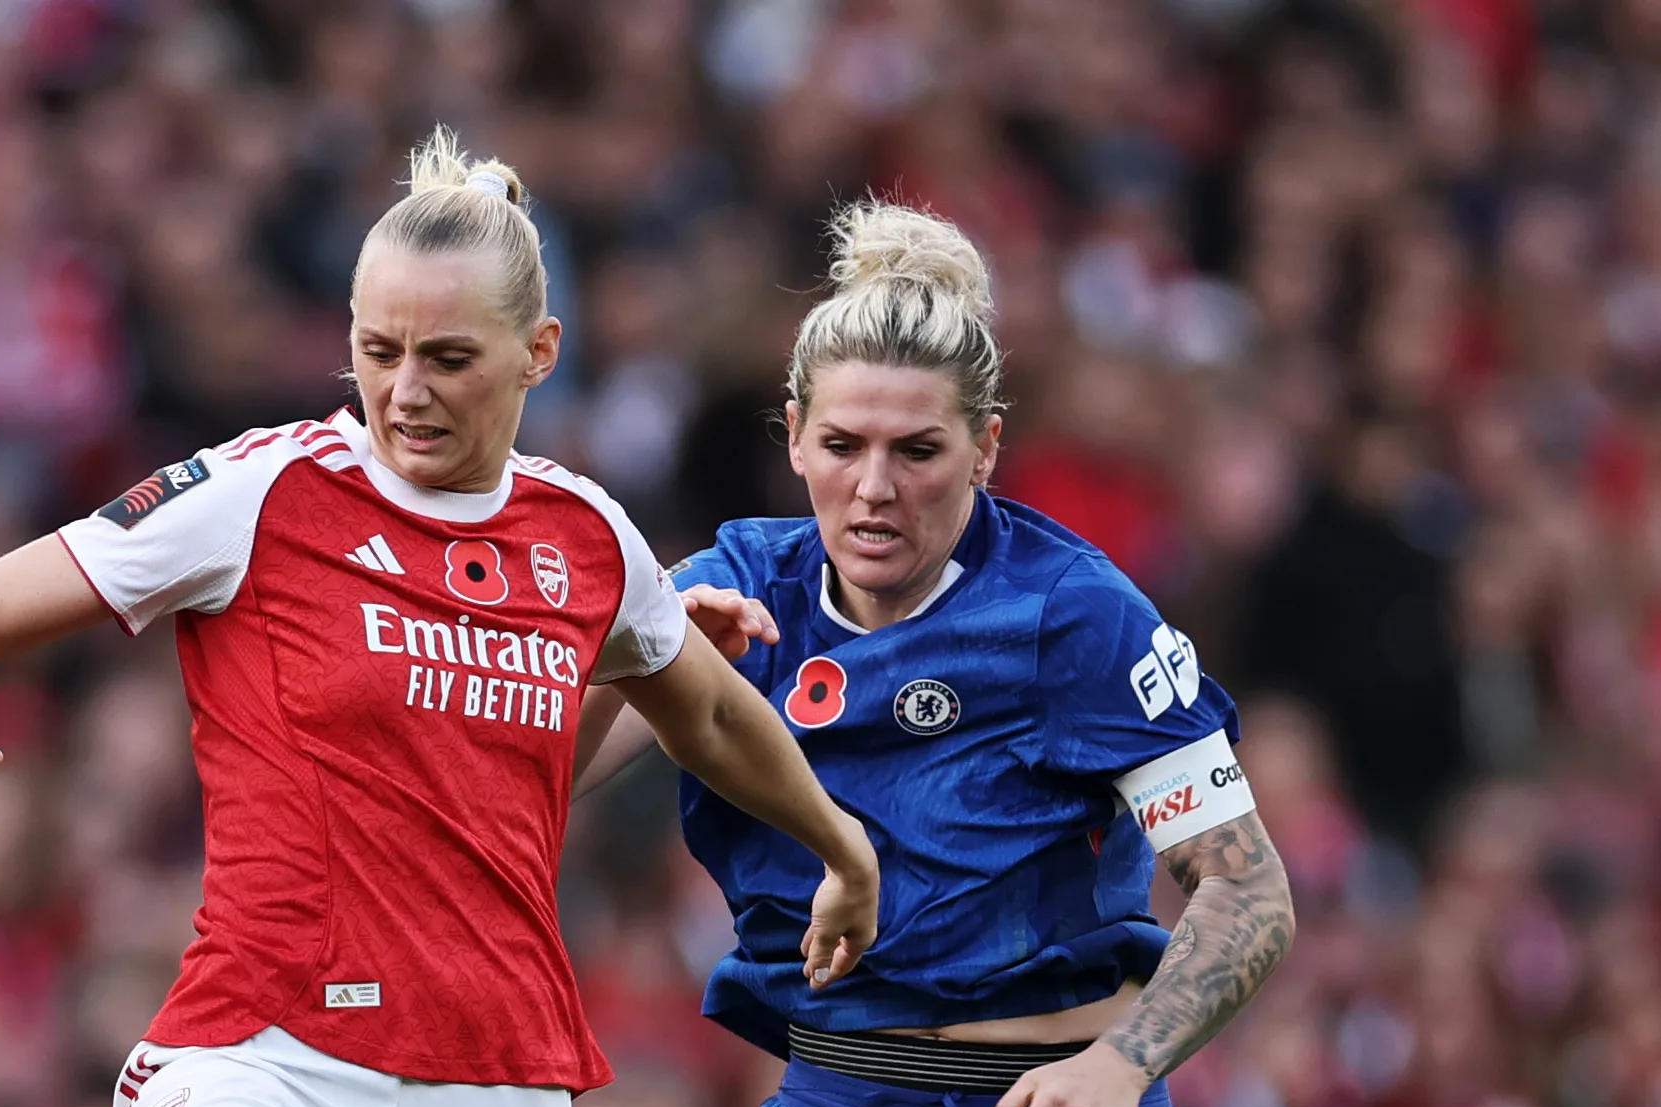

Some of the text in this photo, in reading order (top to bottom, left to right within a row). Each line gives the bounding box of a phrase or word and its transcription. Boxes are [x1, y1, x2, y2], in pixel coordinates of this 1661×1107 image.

[360, 602, 579, 687] Emirates
[406, 664, 563, 732] FLY BETTER
[1138, 784, 1203, 832] WSL
[1141, 772, 1190, 800] BARCLAYS
